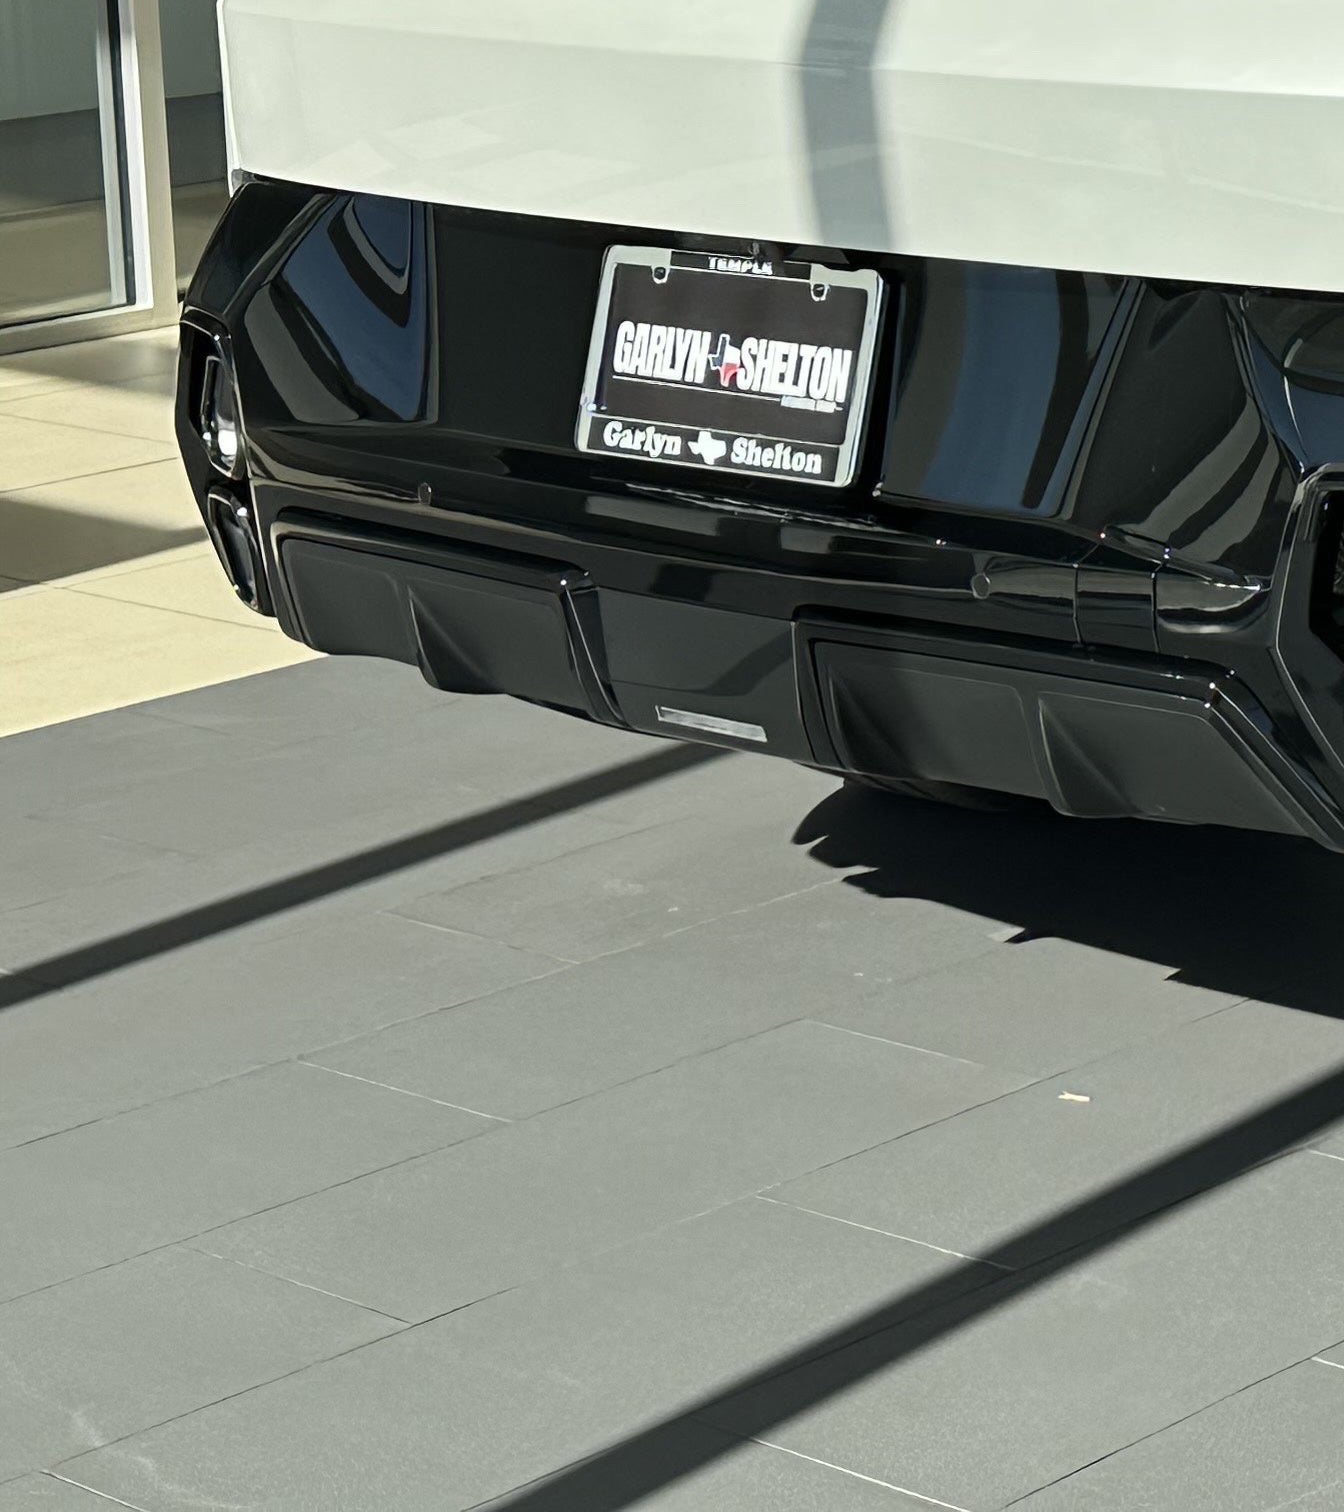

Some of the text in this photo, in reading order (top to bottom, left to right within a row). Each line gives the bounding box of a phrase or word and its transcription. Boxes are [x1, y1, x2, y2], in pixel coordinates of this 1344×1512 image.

[708, 256, 773, 275] TEMPLE
[612, 320, 854, 404] GARLYN SHELTON
[602, 420, 823, 476] Garlyn Shelton
